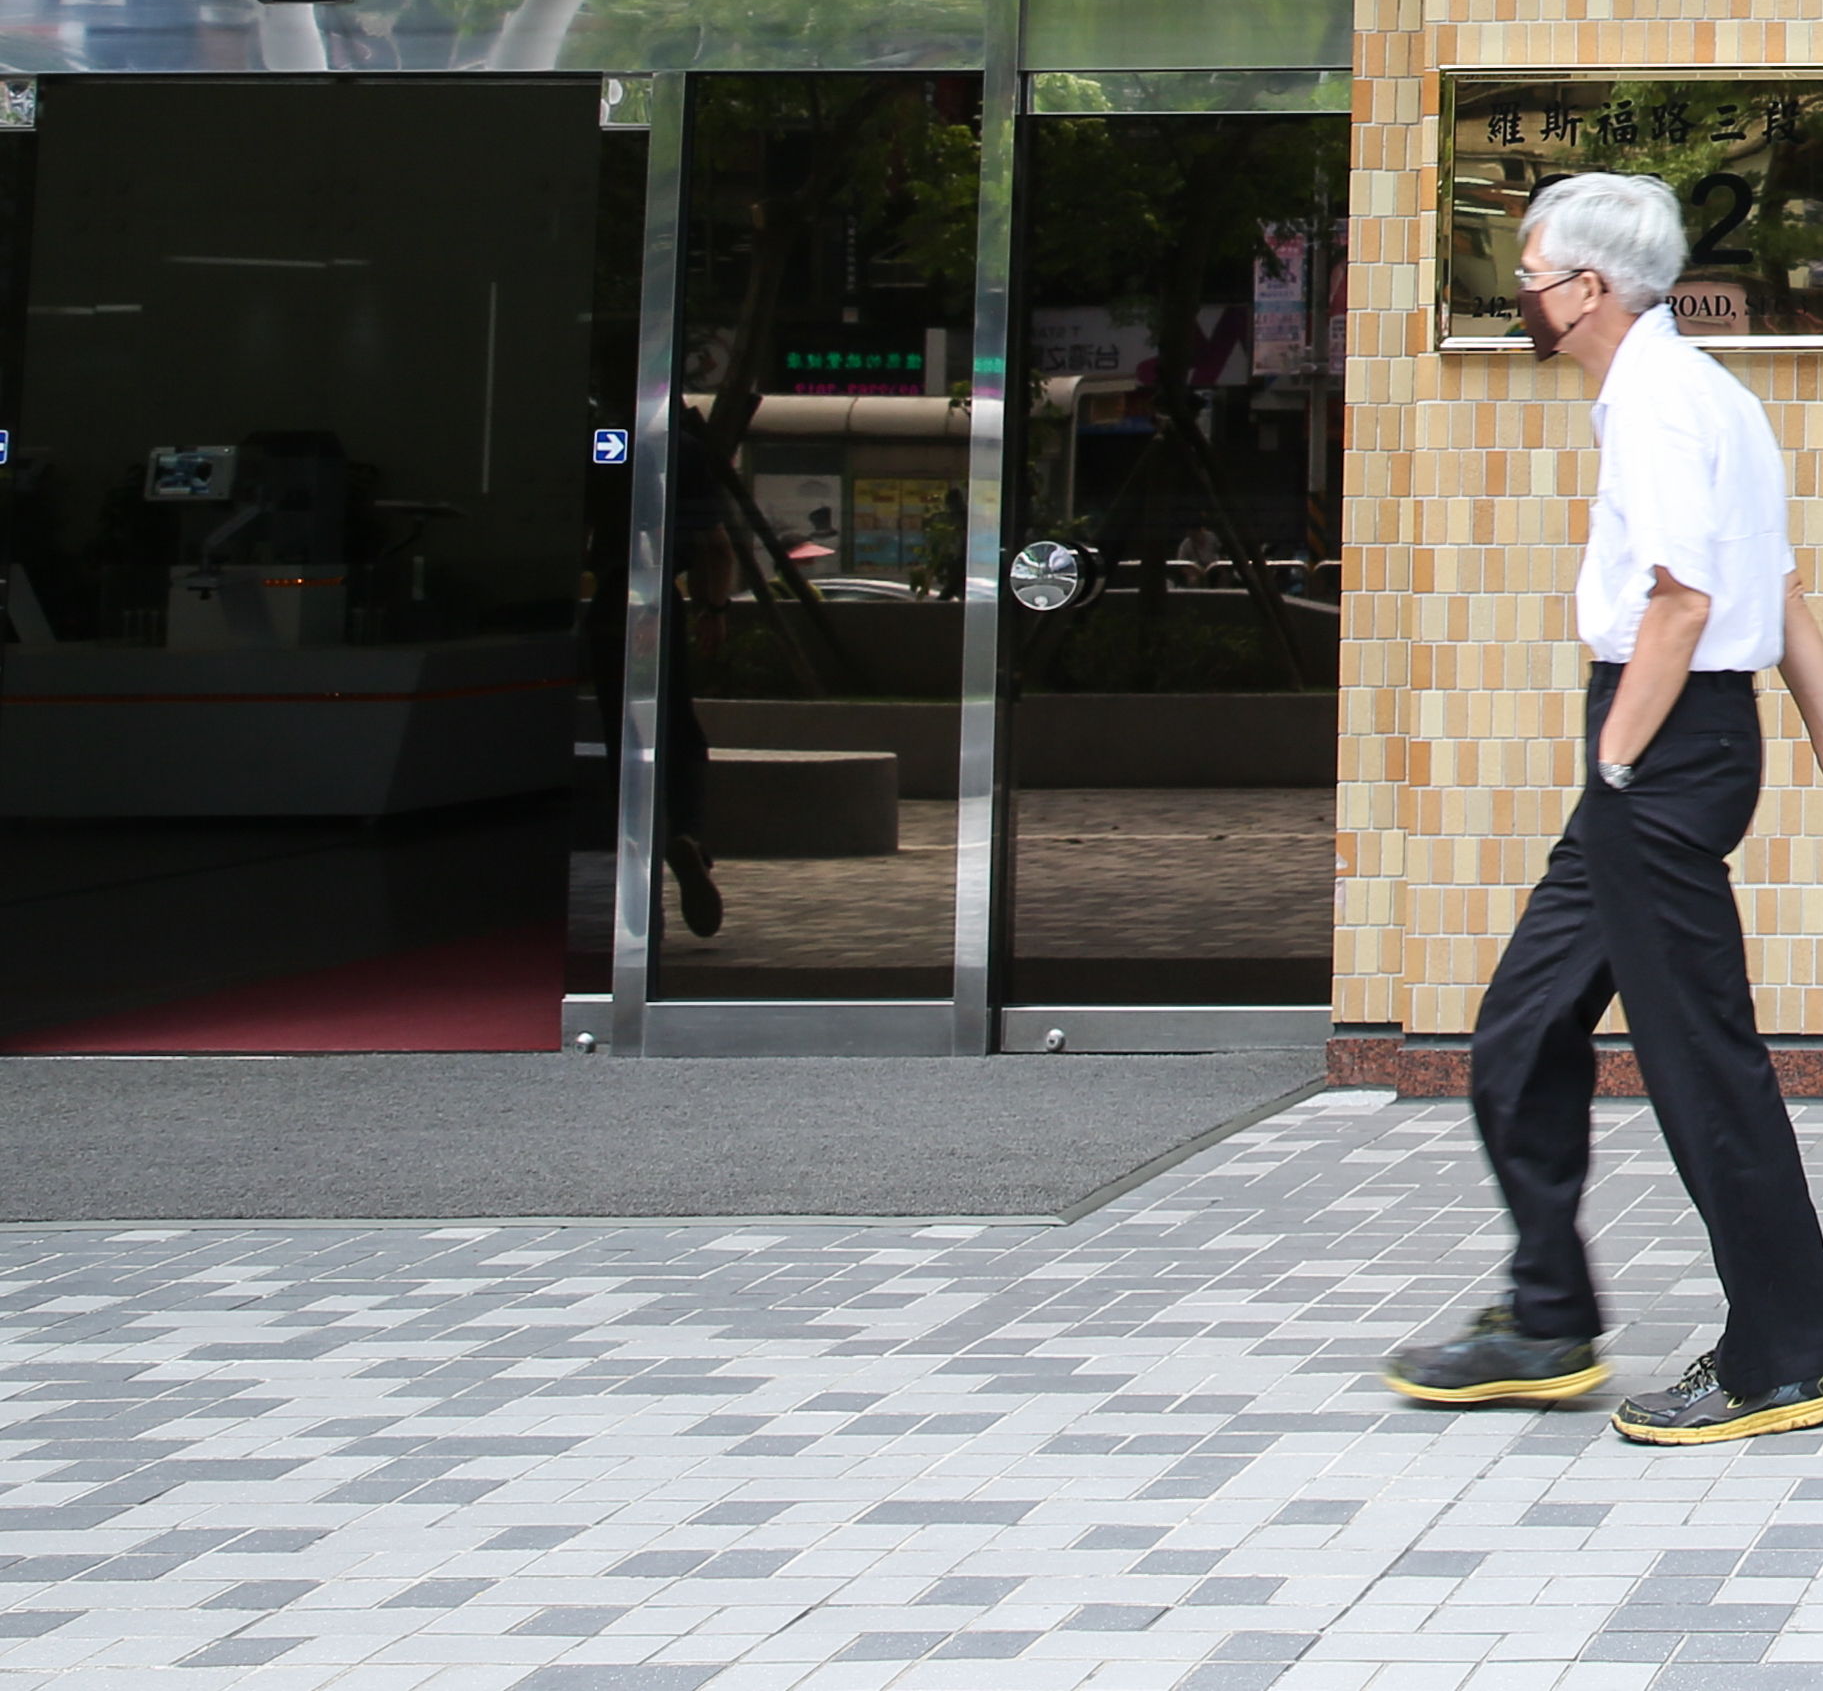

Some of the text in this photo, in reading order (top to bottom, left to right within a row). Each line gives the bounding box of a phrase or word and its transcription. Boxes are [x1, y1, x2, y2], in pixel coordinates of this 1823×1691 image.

[1486, 99, 1802, 146] 羅斯福路三段
[1665, 294, 1737, 321] ROAD,
